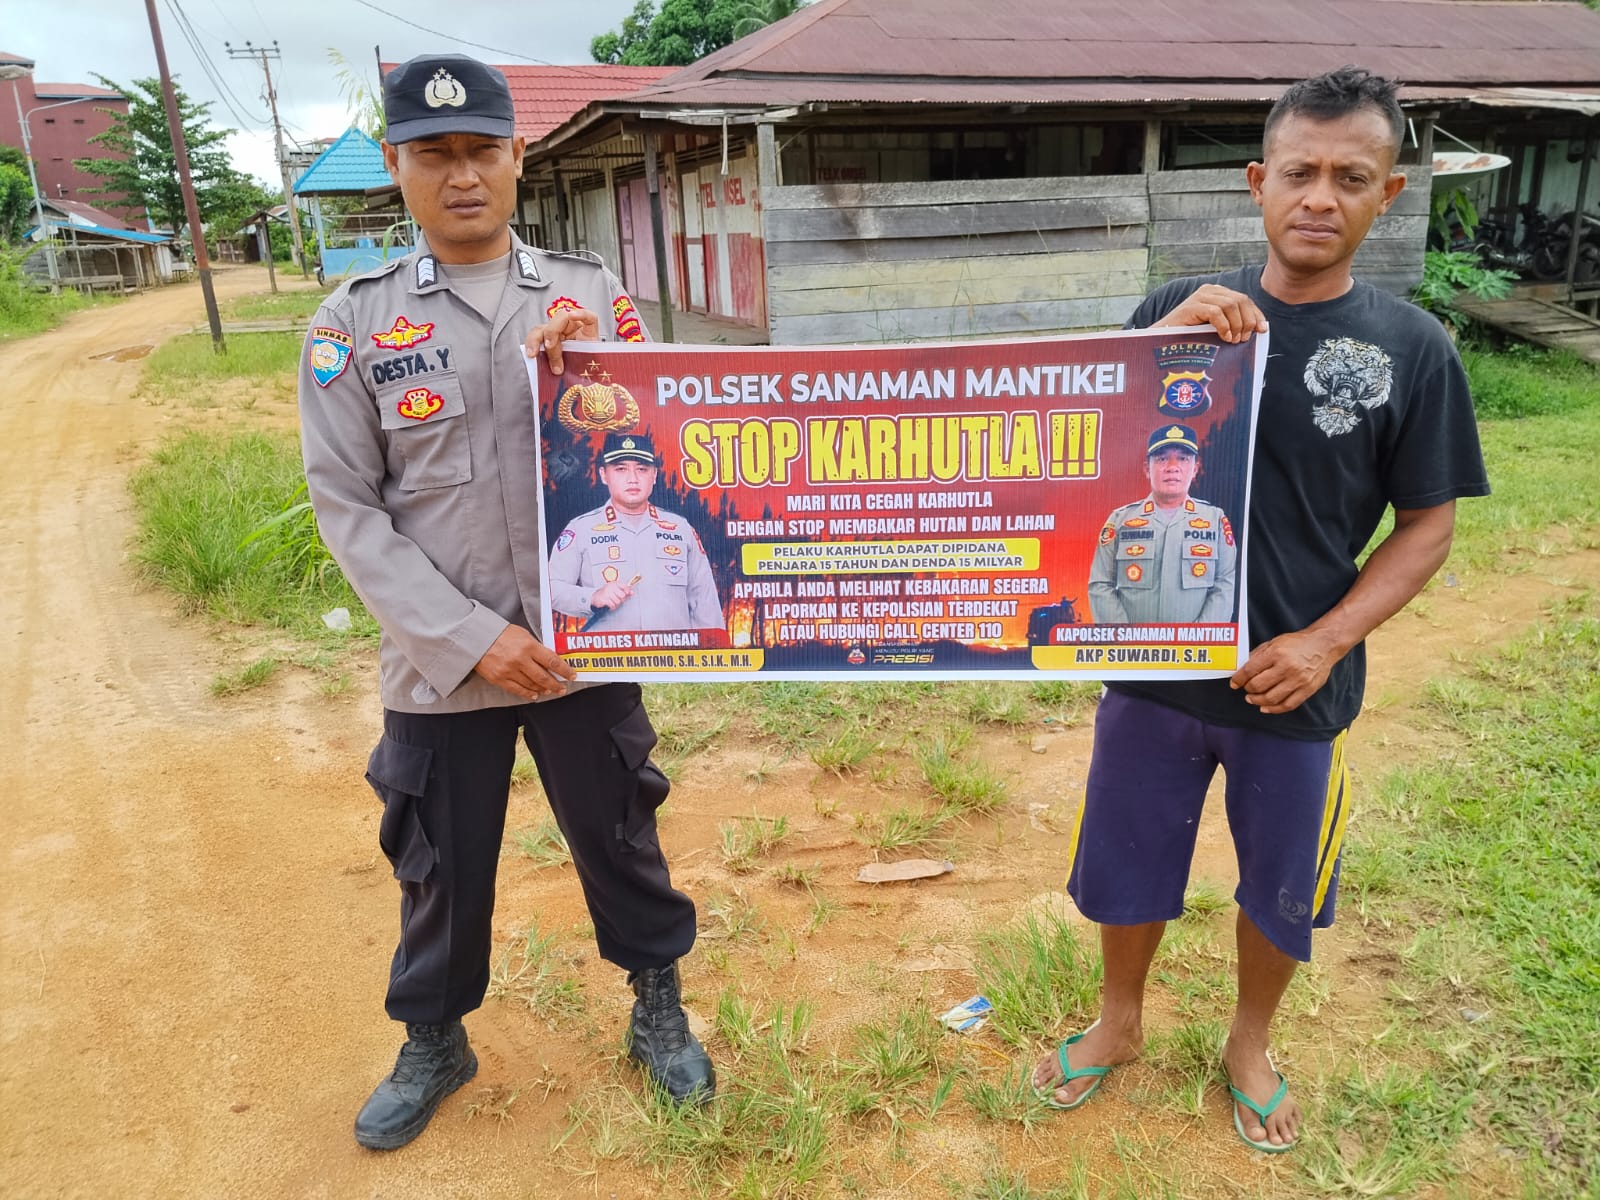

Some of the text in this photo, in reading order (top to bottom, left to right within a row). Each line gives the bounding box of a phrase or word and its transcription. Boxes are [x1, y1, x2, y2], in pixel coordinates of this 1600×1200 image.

[656, 363, 1125, 405] POLSEK SANAMAN MANTIKEI
[681, 411, 1100, 487] STOP KARHUTLA !!!
[786, 491, 993, 512] MARI KITA CEGAH KARHUTLA
[727, 514, 1055, 537] DENGAN STOP MEMBAKAR HUTAN DAN LAHAN
[591, 534, 619, 545] DODIK
[656, 532, 683, 542] POLRI
[1184, 530, 1216, 541] POLRI
[774, 543, 1006, 557] PELAKU KARHUTLA DAPAT DIPIDANA
[758, 556, 1023, 571] PENJARA 15 TAHUN DAN DENDA 15 MILYAR
[734, 577, 1049, 599] APABILA ANDA MELIHAT KEBAKARAN SEGERA
[764, 600, 1018, 619] LAPORKAN KE KEPOLISIAN TERDEKAT
[780, 622, 1003, 640] ATAU HUBUNGI CALL CENTER 110
[1056, 627, 1235, 642] KAPOLSEK SANAMAN MANTIKEI
[567, 633, 698, 650] KAPOLRES KATINGAN
[592, 657, 625, 669] DODIK
[626, 656, 677, 669] HARTONO,
[678, 655, 700, 669] S.H.,
[702, 655, 729, 668] S.I.K.,
[730, 655, 752, 667] M.H.
[872, 654, 935, 664] PRESISI
[1076, 648, 1212, 664] AKP SUWARDI, S.H.
